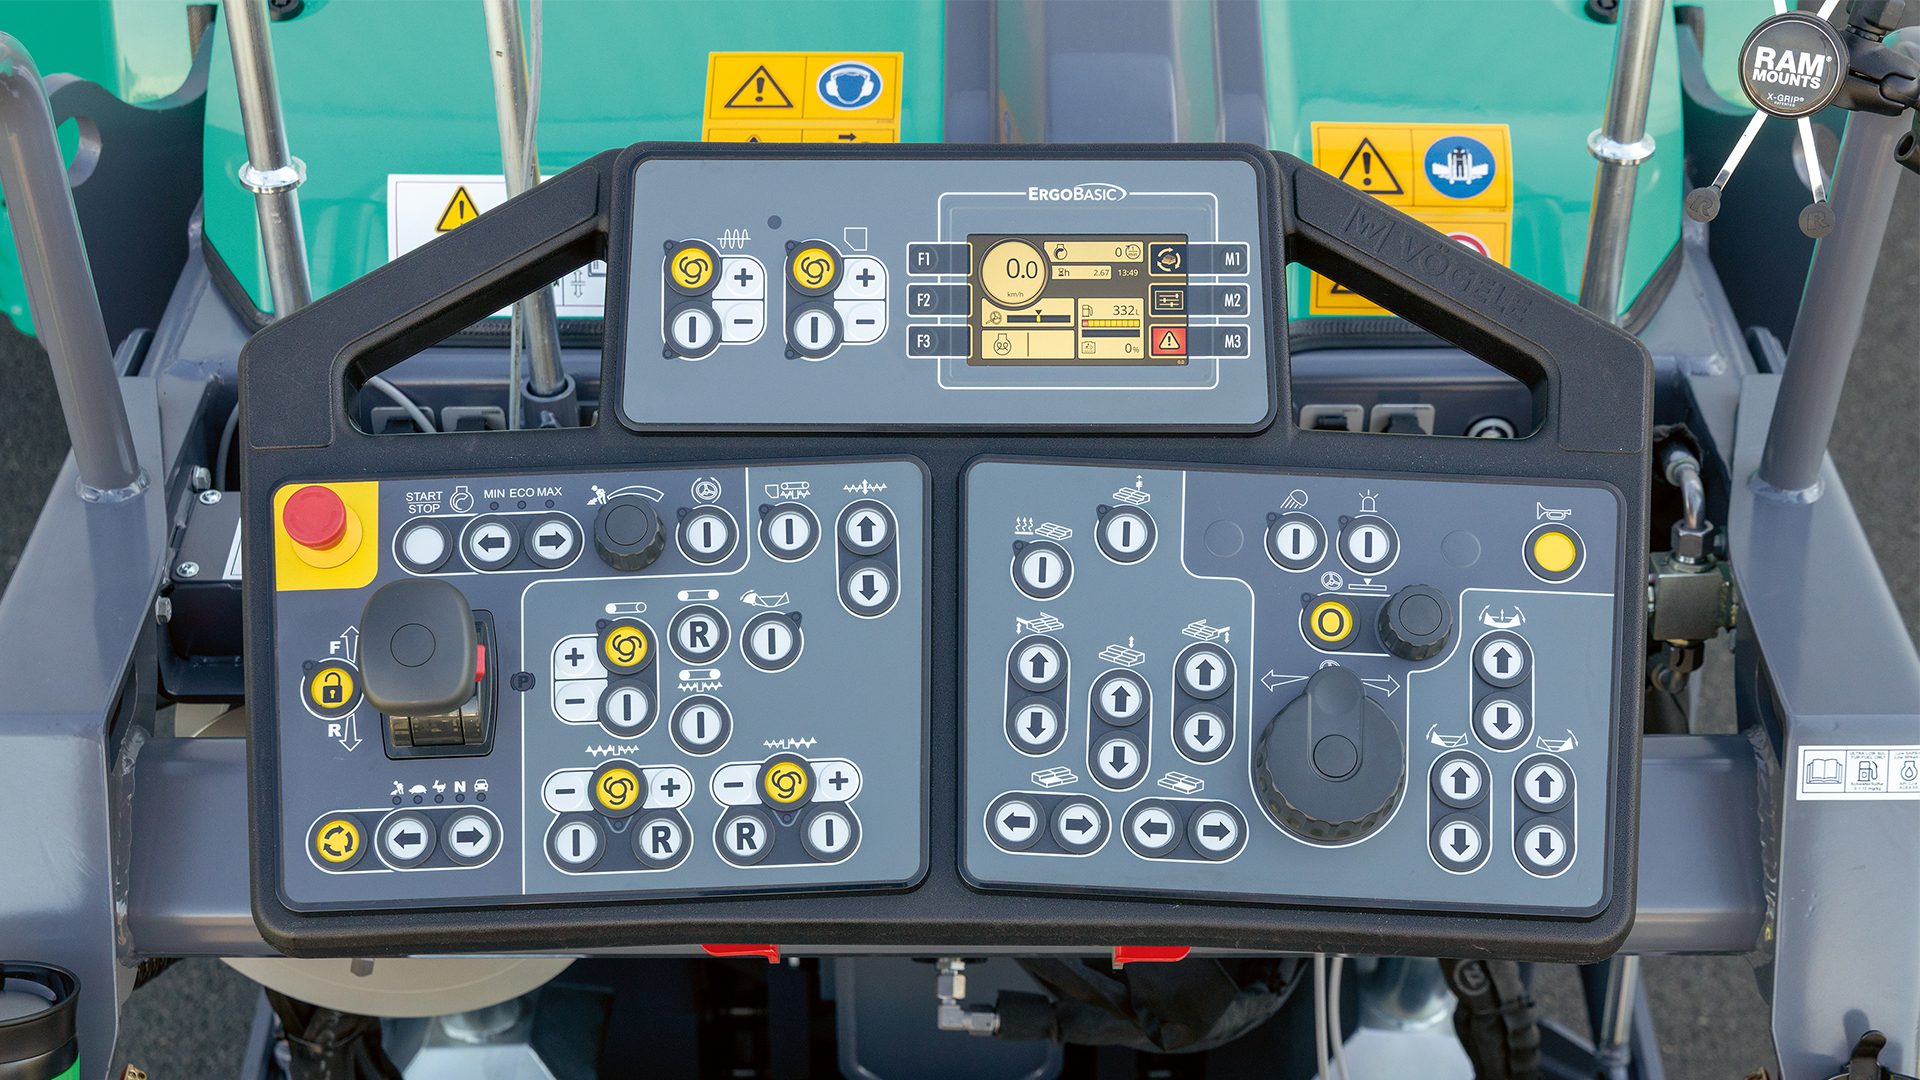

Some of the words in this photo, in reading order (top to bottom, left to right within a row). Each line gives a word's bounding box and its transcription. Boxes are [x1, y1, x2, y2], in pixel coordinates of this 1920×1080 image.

[1752, 68, 1821, 90] MOUNTS
[918, 252, 930, 266] F1
[1115, 246, 1122, 258] 0
[1225, 252, 1240, 266] M1
[1006, 258, 1038, 279] 0.0
[1093, 269, 1110, 277] 2.67
[1117, 269, 1139, 277] 13:49
[917, 293, 930, 307] F2
[1224, 293, 1241, 307] M2
[917, 334, 930, 348] F3
[1224, 334, 1242, 348] M3
[405, 491, 443, 501] START
[484, 488, 506, 499] MIN
[509, 488, 535, 498] ECO
[537, 487, 563, 497] MAX
[408, 504, 441, 514] STOP
[690, 621, 710, 648] R
[329, 641, 341, 655] F
[328, 723, 342, 737] R
[454, 781, 466, 793] N
[652, 826, 672, 853] R
[737, 823, 757, 850] R
